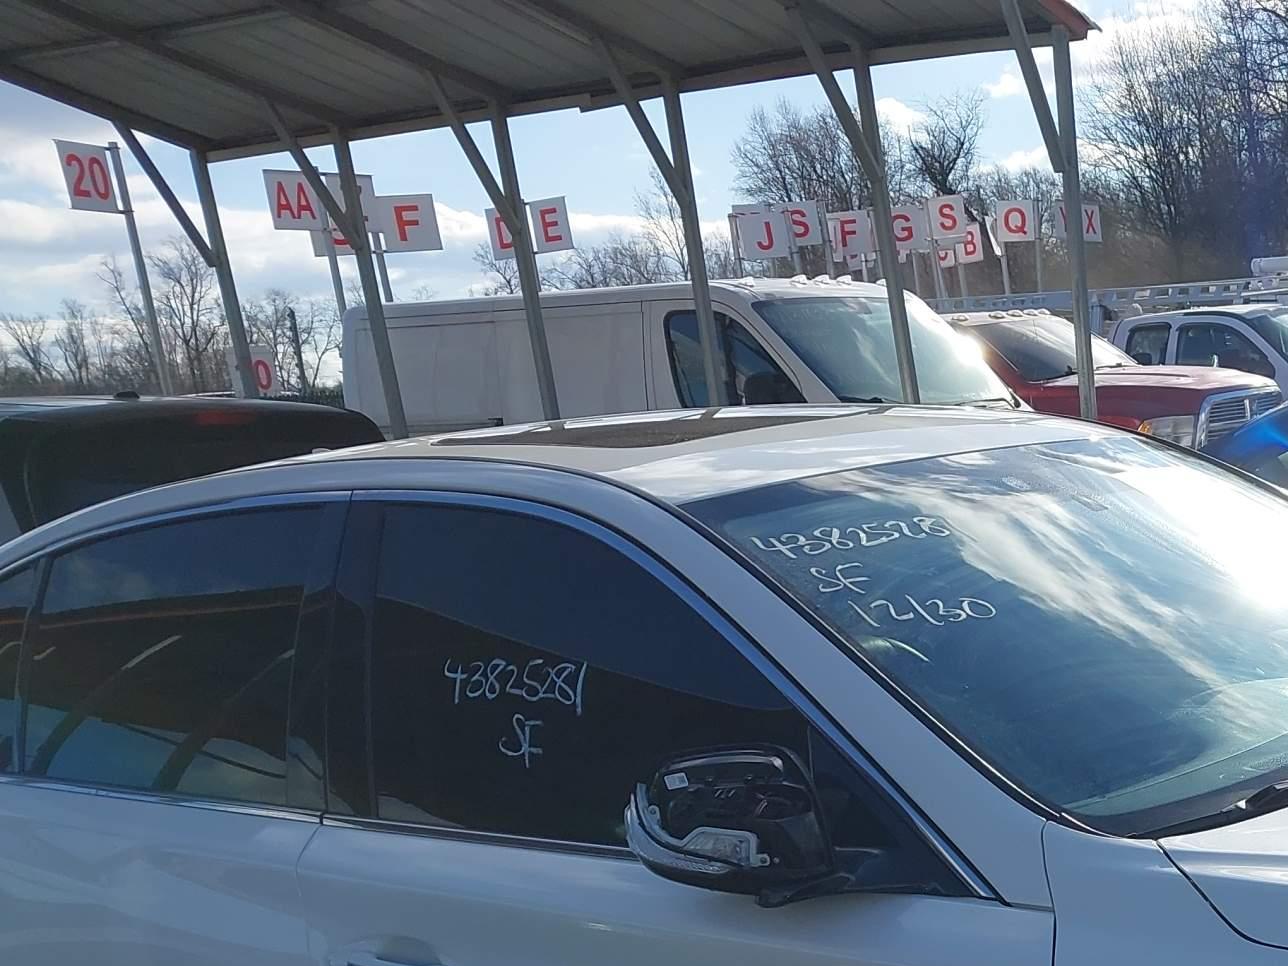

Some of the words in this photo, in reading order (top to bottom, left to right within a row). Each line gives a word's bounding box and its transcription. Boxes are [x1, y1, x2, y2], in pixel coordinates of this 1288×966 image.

[65, 153, 110, 200] 20
[276, 181, 317, 220] AA
[394, 205, 420, 242] F
[539, 207, 562, 243] E
[789, 208, 810, 238] S
[892, 214, 914, 242] G
[938, 203, 957, 231] S
[1004, 207, 1028, 235] Q
[1084, 209, 1097, 235] X
[756, 221, 774, 251] J
[840, 219, 857, 247] F
[963, 230, 977, 257] B
[847, 594, 997, 627] 12/30
[444, 657, 588, 716] 43825281
